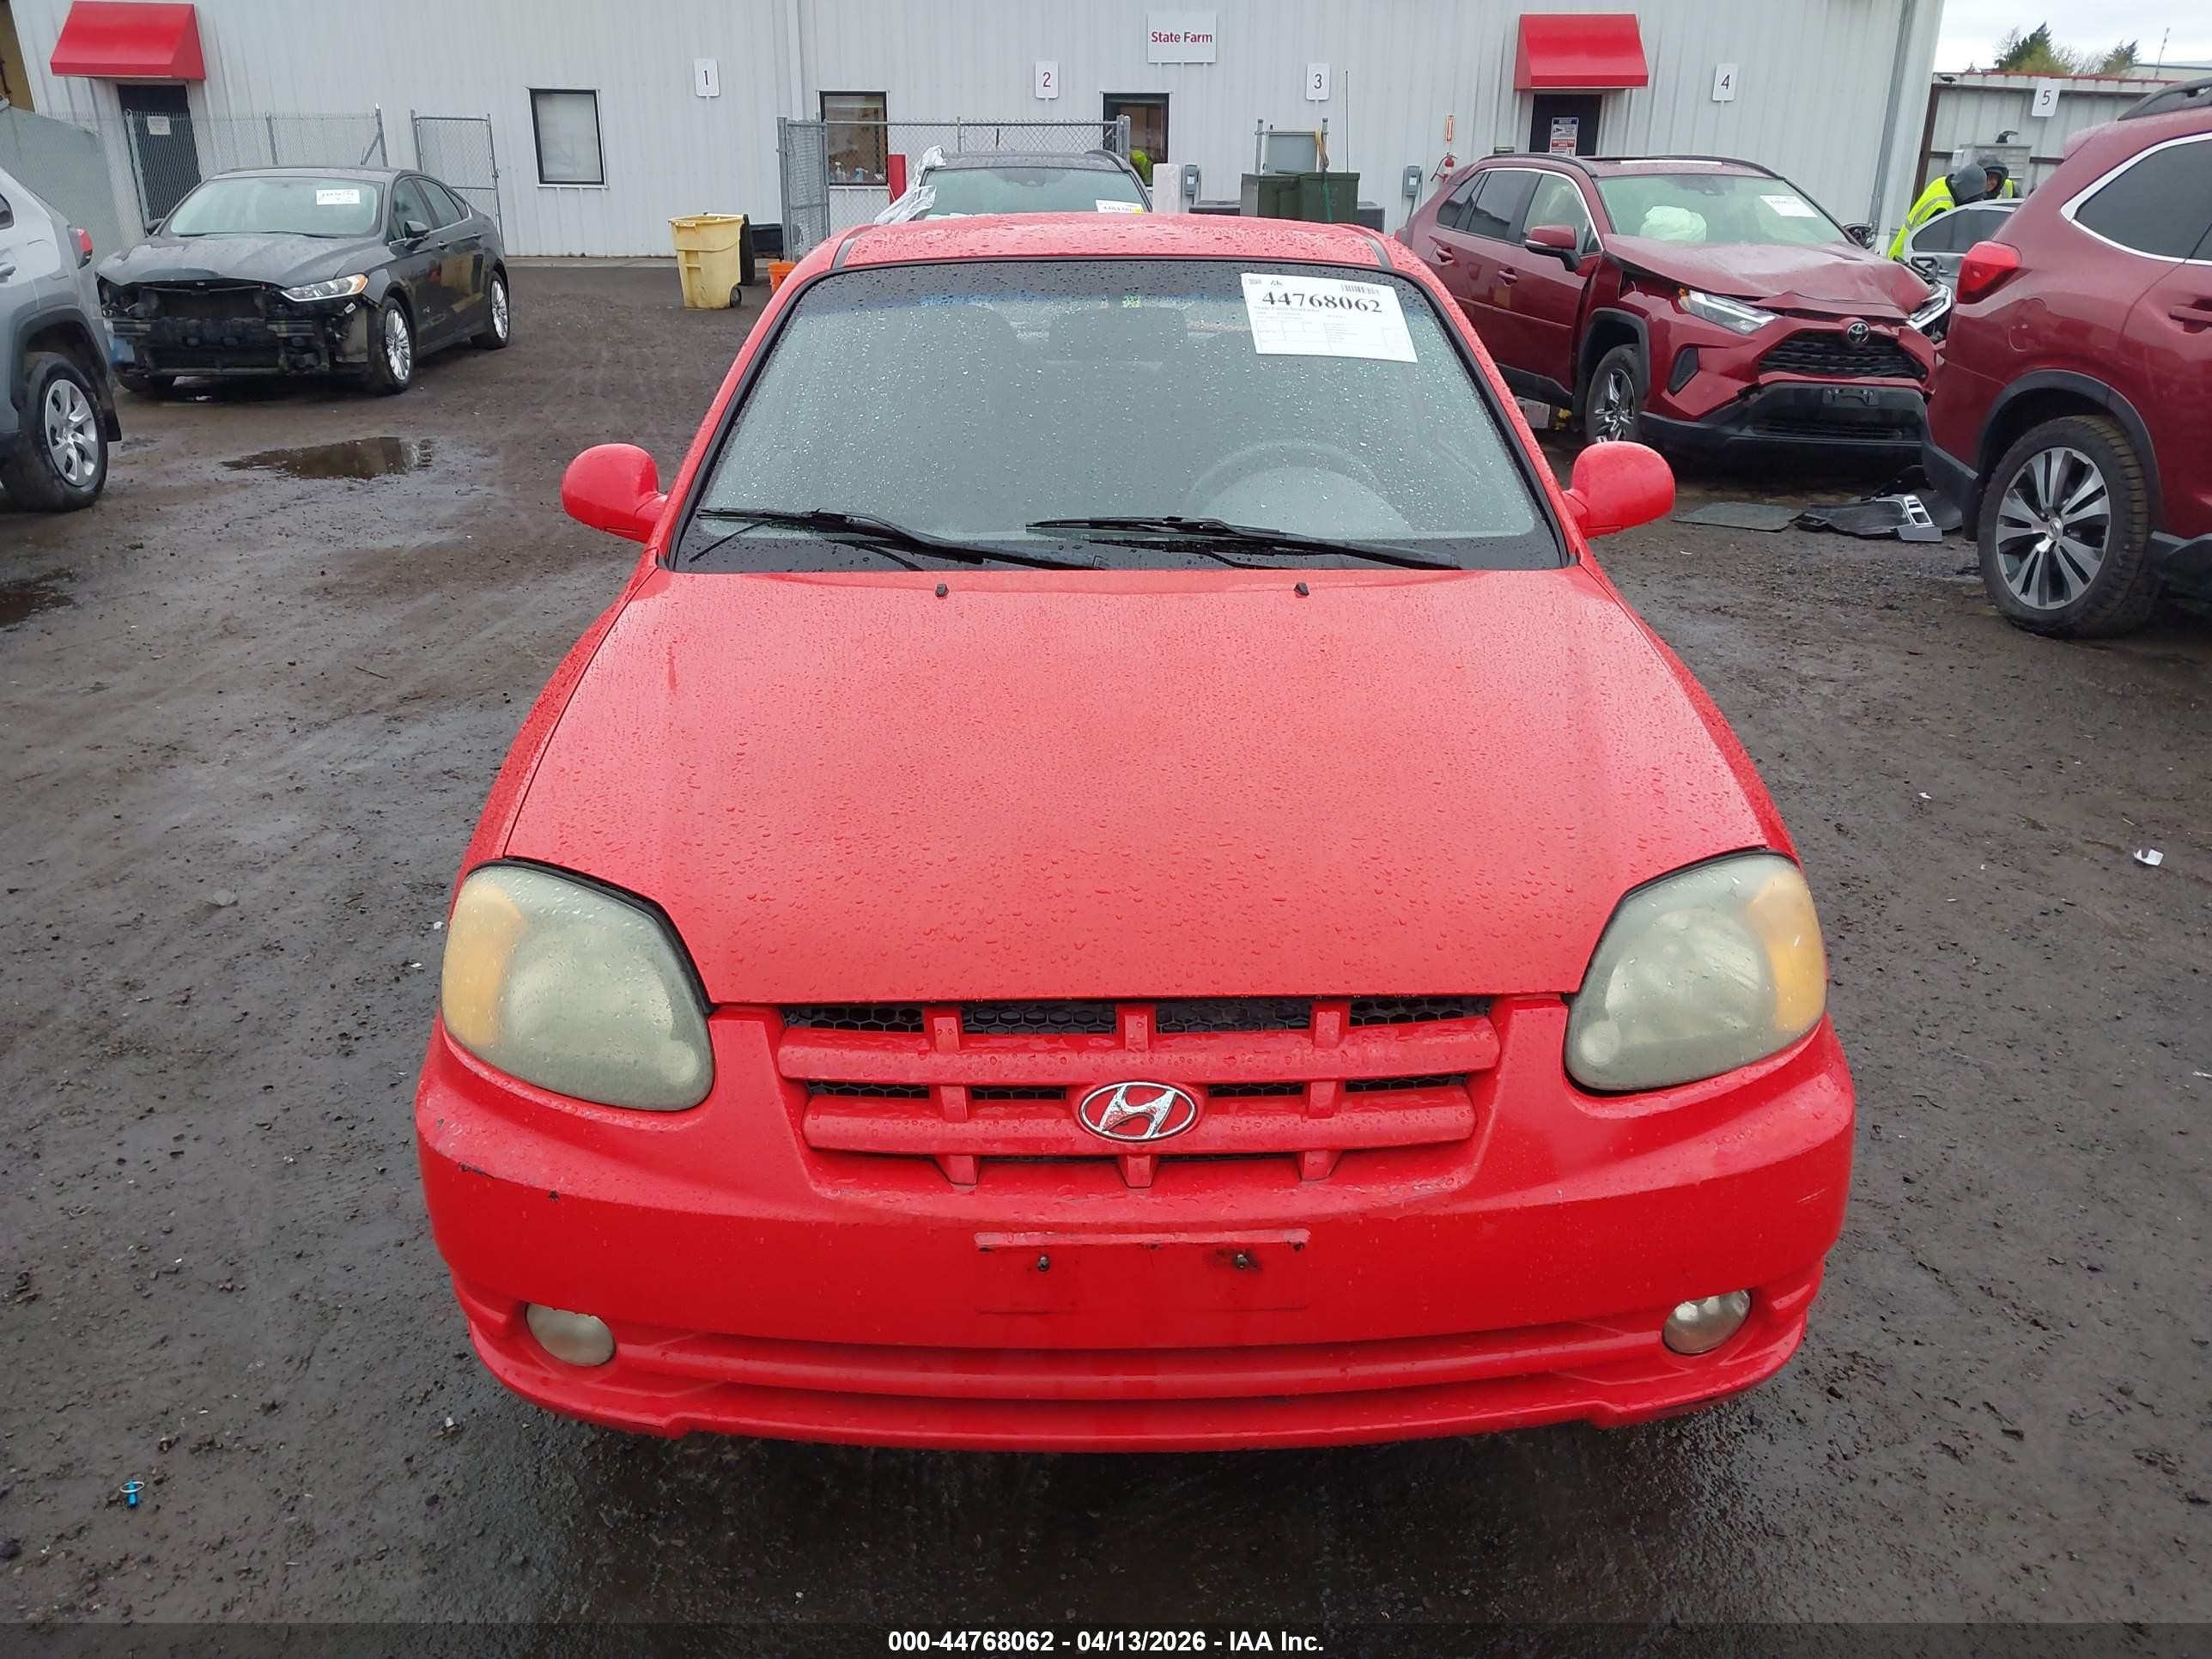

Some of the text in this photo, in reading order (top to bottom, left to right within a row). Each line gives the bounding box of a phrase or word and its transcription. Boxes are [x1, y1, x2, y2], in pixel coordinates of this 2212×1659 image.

[1151, 31, 1212, 43] State Farm
[703, 70, 708, 86] 1
[1042, 71, 1052, 88] 2
[1313, 73, 1323, 89] 3
[1721, 74, 1730, 90] 4
[2041, 89, 2051, 106] 5
[1261, 290, 1382, 313] 44768062
